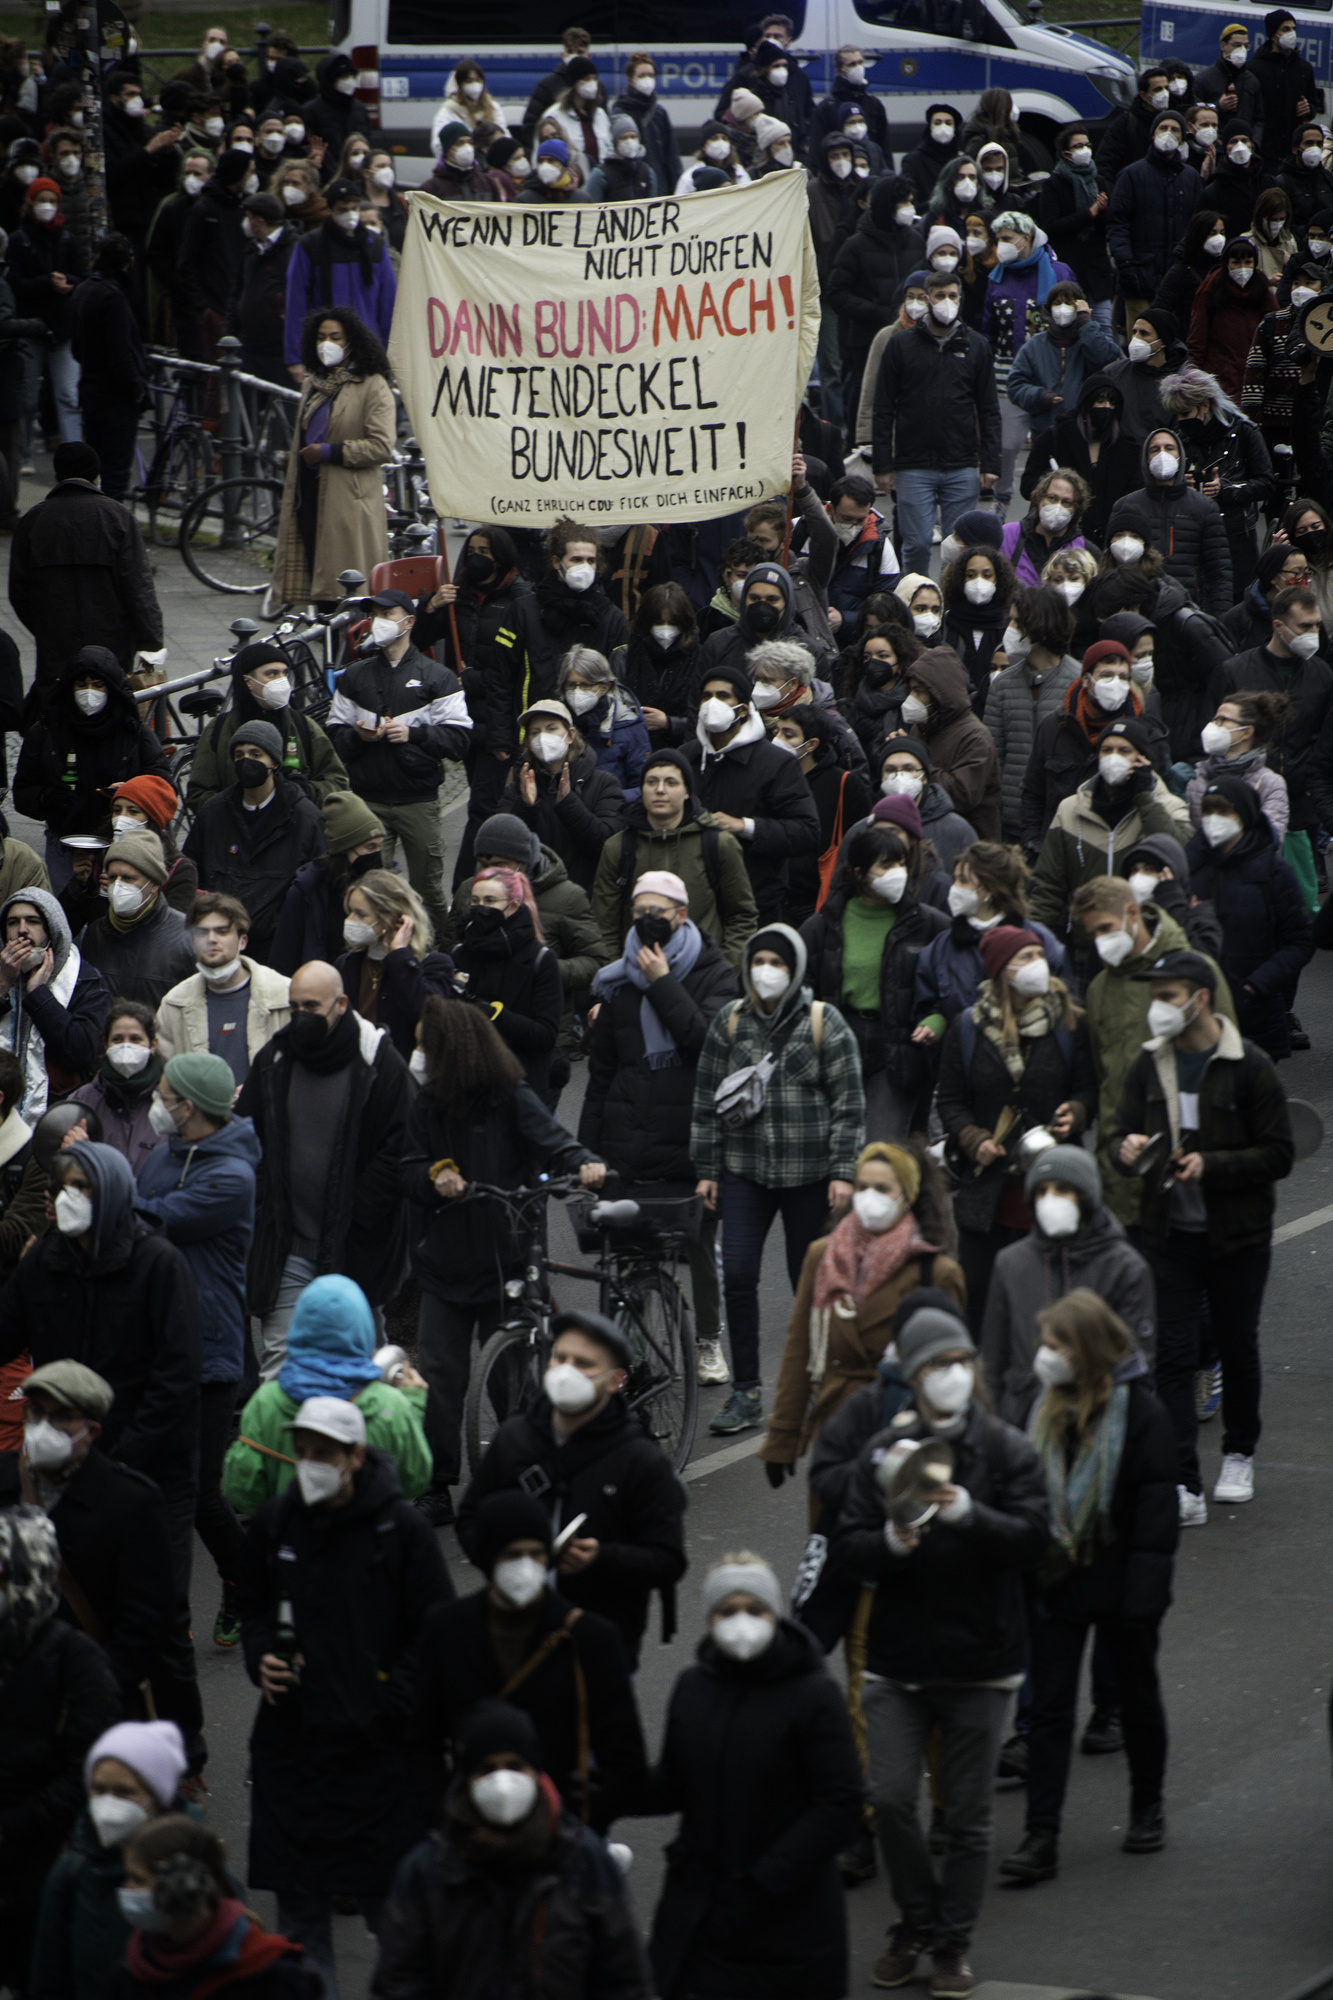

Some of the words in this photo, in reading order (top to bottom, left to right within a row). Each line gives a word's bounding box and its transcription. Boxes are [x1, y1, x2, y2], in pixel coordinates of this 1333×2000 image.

[420, 209, 512, 247] WENN
[523, 211, 563, 247] DIE
[574, 202, 680, 248] LÄNDER
[584, 245, 664, 281] NICHT
[671, 232, 773, 276] DÜRFEN
[427, 297, 523, 358] DANN
[432, 356, 718, 419] MIETENDECKEL
[512, 422, 747, 482] BUNDESWEIT!
[491, 496, 531, 515] (GANZ
[537, 499, 584, 512] EHRLICH
[620, 496, 649, 509] FICK
[656, 492, 688, 507] DICH
